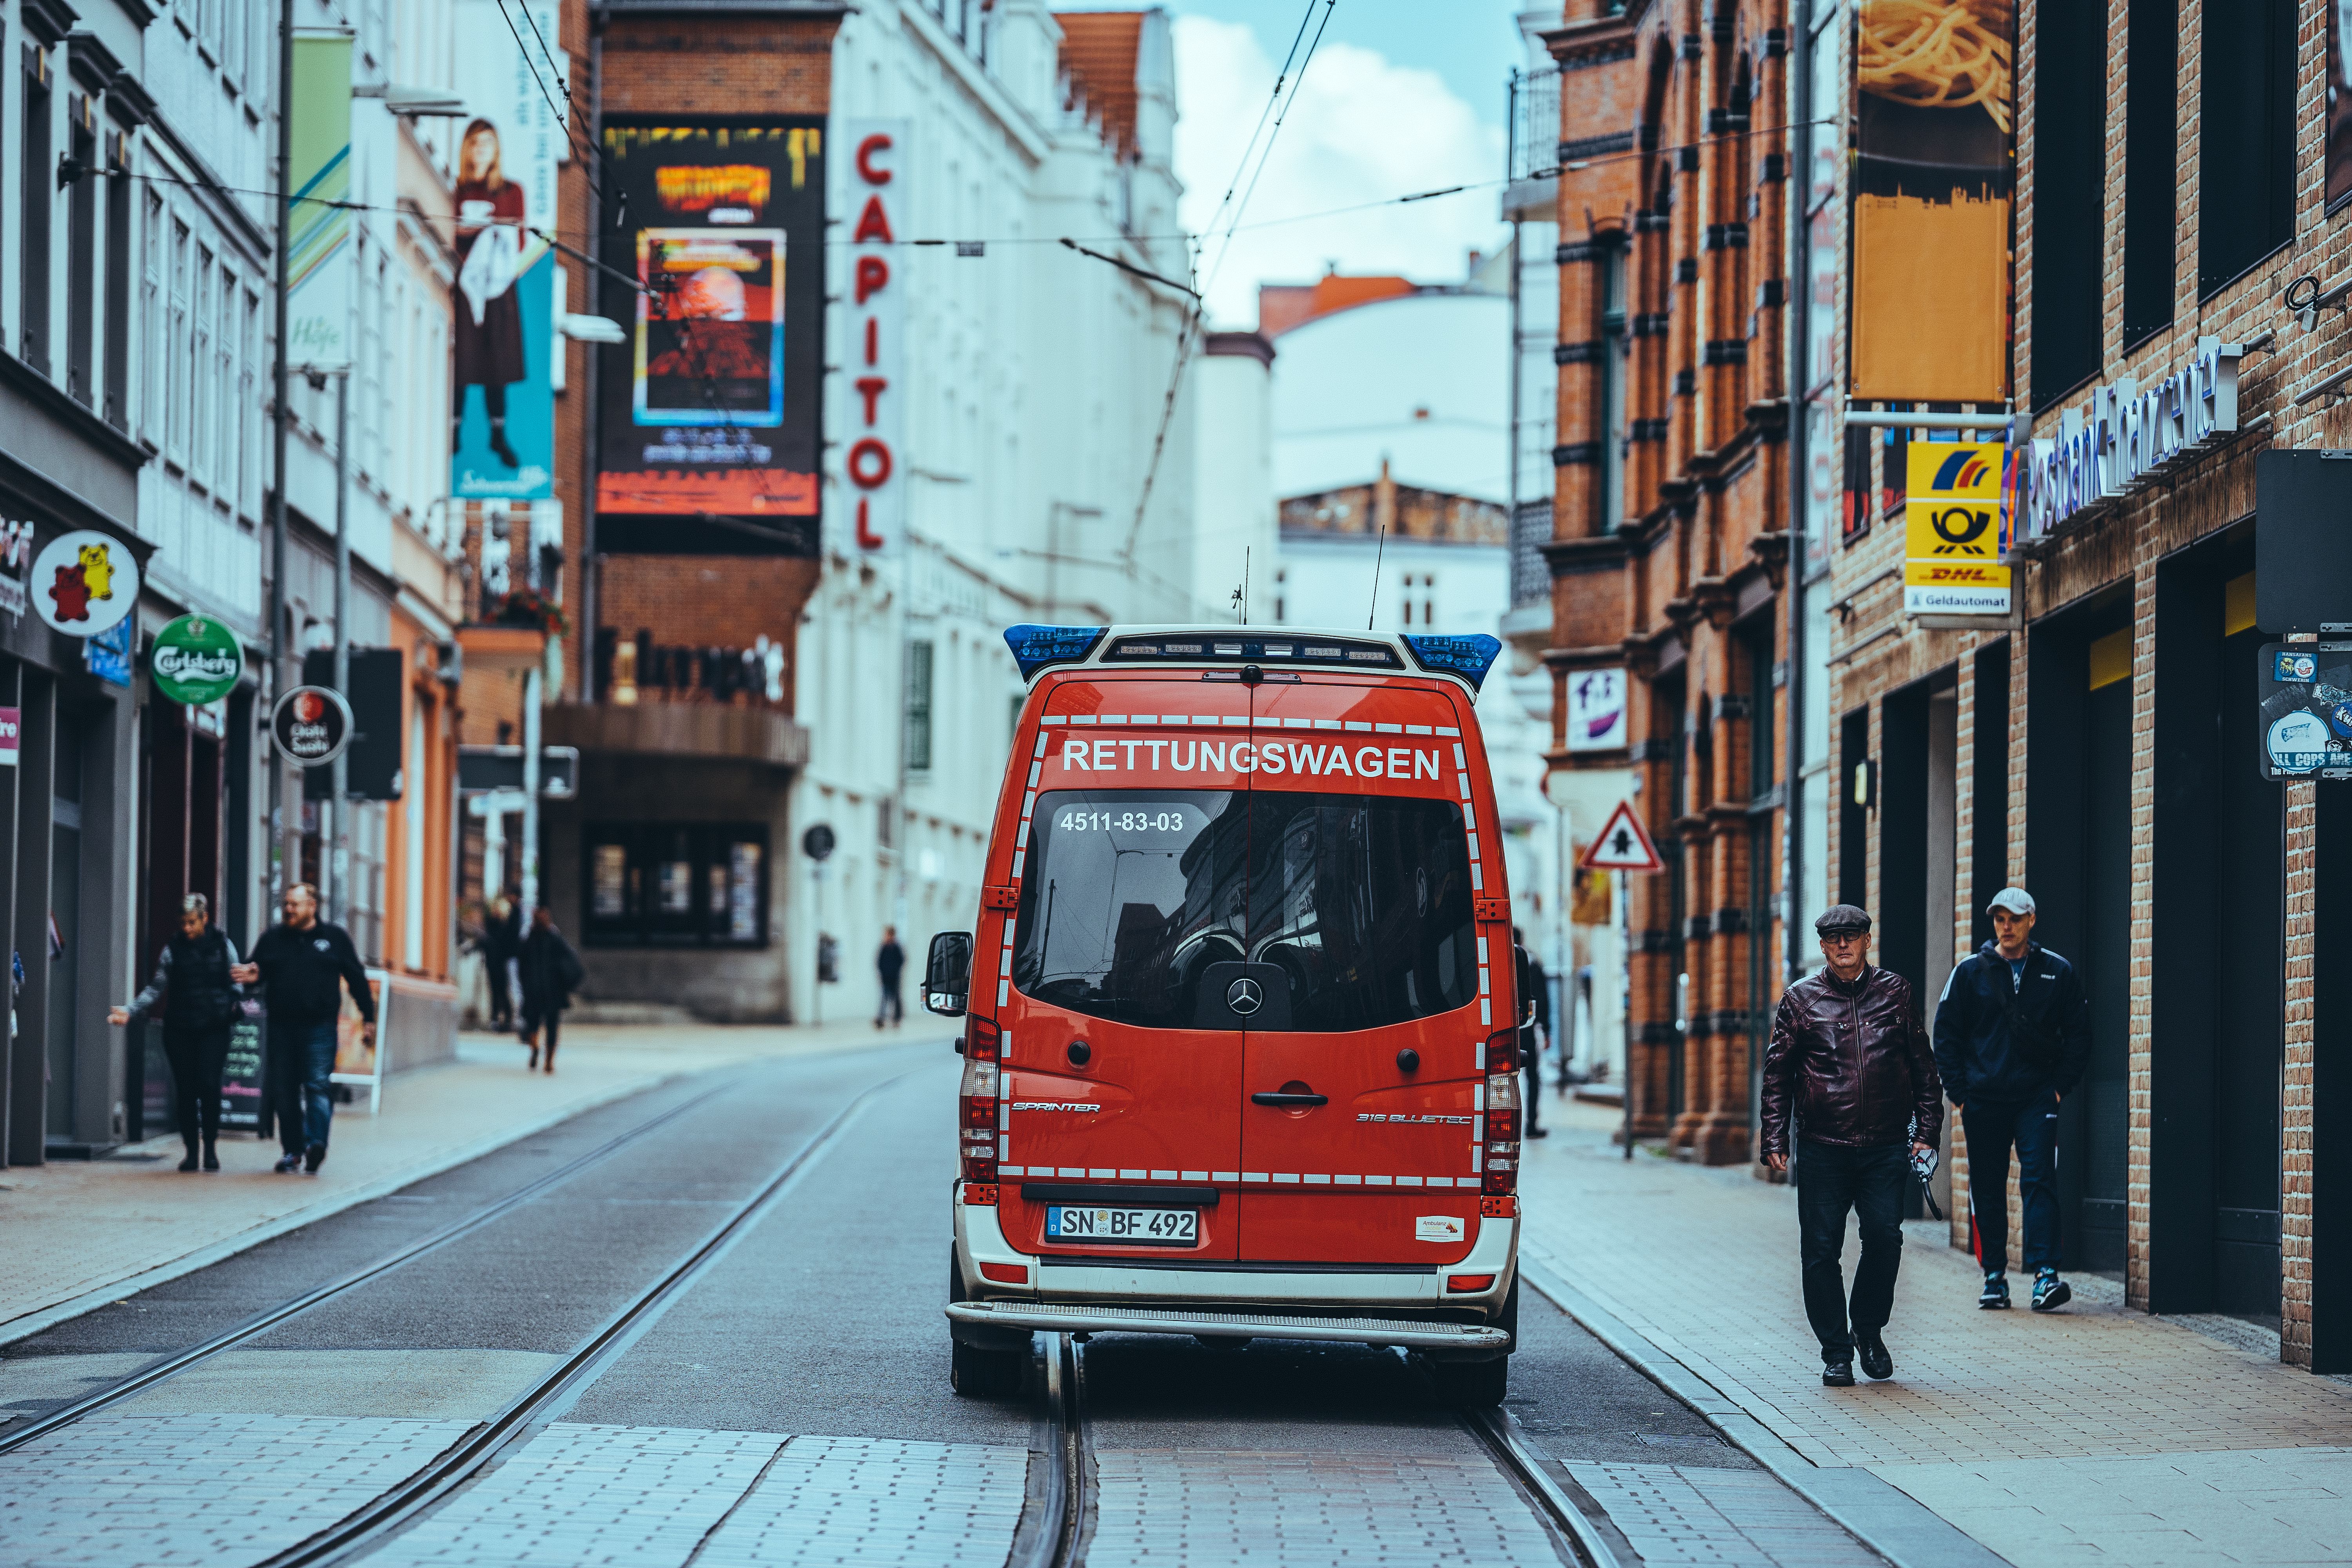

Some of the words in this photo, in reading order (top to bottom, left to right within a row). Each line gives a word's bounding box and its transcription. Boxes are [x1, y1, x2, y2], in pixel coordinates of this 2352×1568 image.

[846, 133, 893, 548] CAPITOL
[2028, 385, 2112, 539] Postbank
[2106, 336, 2243, 490] Finanzcenter
[1930, 568, 1987, 581] DHL
[1926, 595, 2005, 607] Geldautomat
[154, 646, 237, 681] Carlsberg
[1062, 739, 1441, 781] RETTUNGSWAGEN
[2295, 753, 2325, 766] COPS
[2329, 753, 2351, 766] ARE
[1060, 811, 1183, 833] 4511-83-03
[1011, 1102, 1100, 1112] SPRINTER
[1356, 1114, 1387, 1122] 316
[1388, 1114, 1472, 1124] BLUETEC
[1062, 1210, 1094, 1234] SN
[1111, 1211, 1143, 1235] BF
[1149, 1212, 1194, 1237] 492
